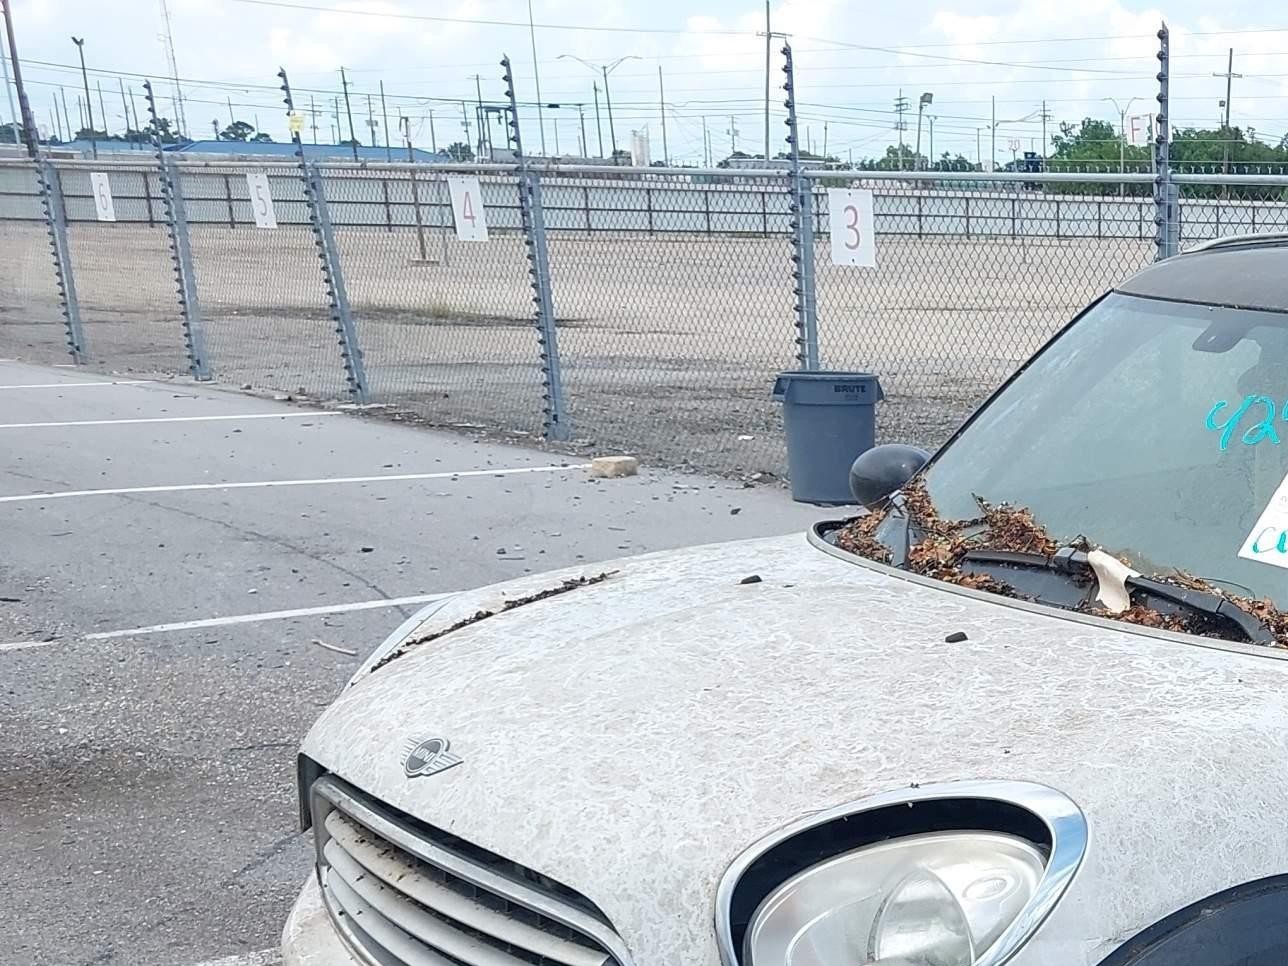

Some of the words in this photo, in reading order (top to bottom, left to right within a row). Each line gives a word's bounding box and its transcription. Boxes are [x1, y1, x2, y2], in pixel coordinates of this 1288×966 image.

[99, 183, 108, 210] 6
[256, 185, 268, 217] 5
[463, 191, 477, 228] 4
[843, 205, 860, 250] 3
[833, 384, 867, 393] BRUTE
